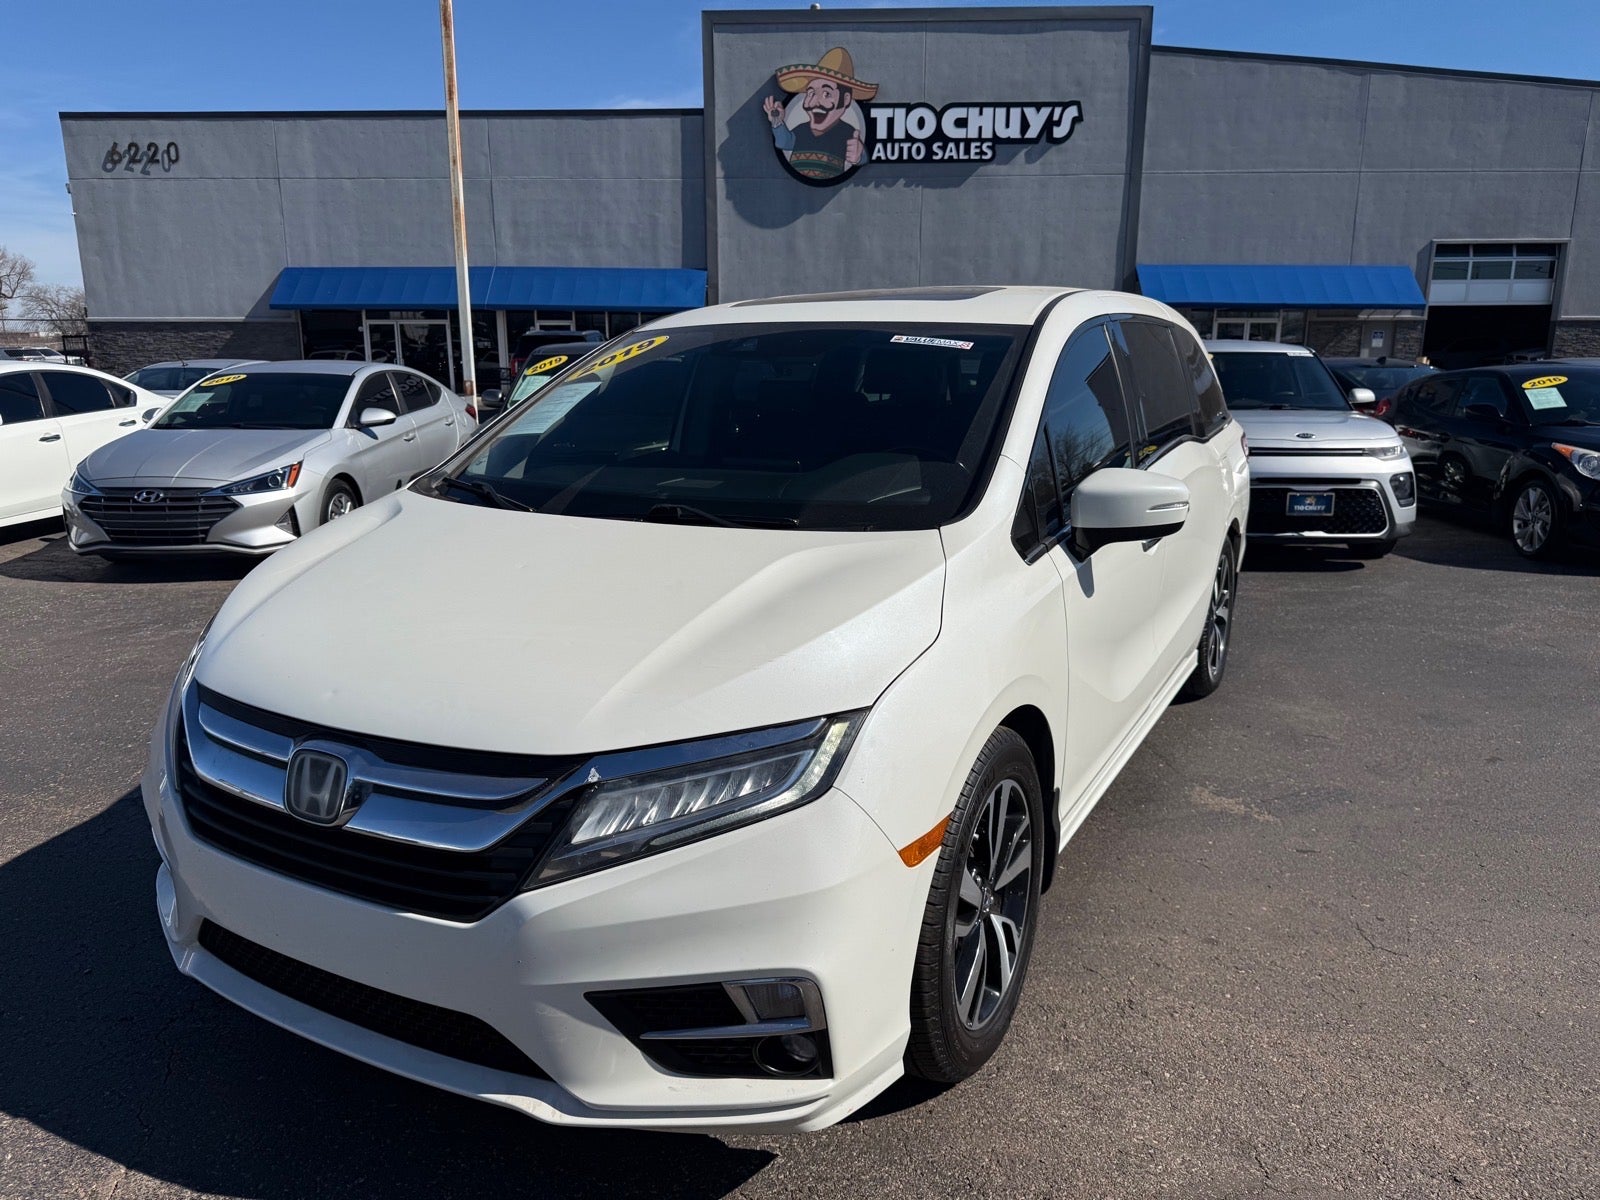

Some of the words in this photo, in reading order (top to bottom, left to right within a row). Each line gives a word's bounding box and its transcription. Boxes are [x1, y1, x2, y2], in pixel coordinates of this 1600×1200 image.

[870, 107, 937, 139] TIO
[941, 105, 1078, 139] CHUY'S
[110, 142, 179, 164] 6220
[872, 142, 926, 160] AUTO
[932, 142, 994, 160] SALES
[531, 356, 563, 373] 2019
[577, 340, 655, 377] 2019
[1528, 377, 1562, 388] 2016
